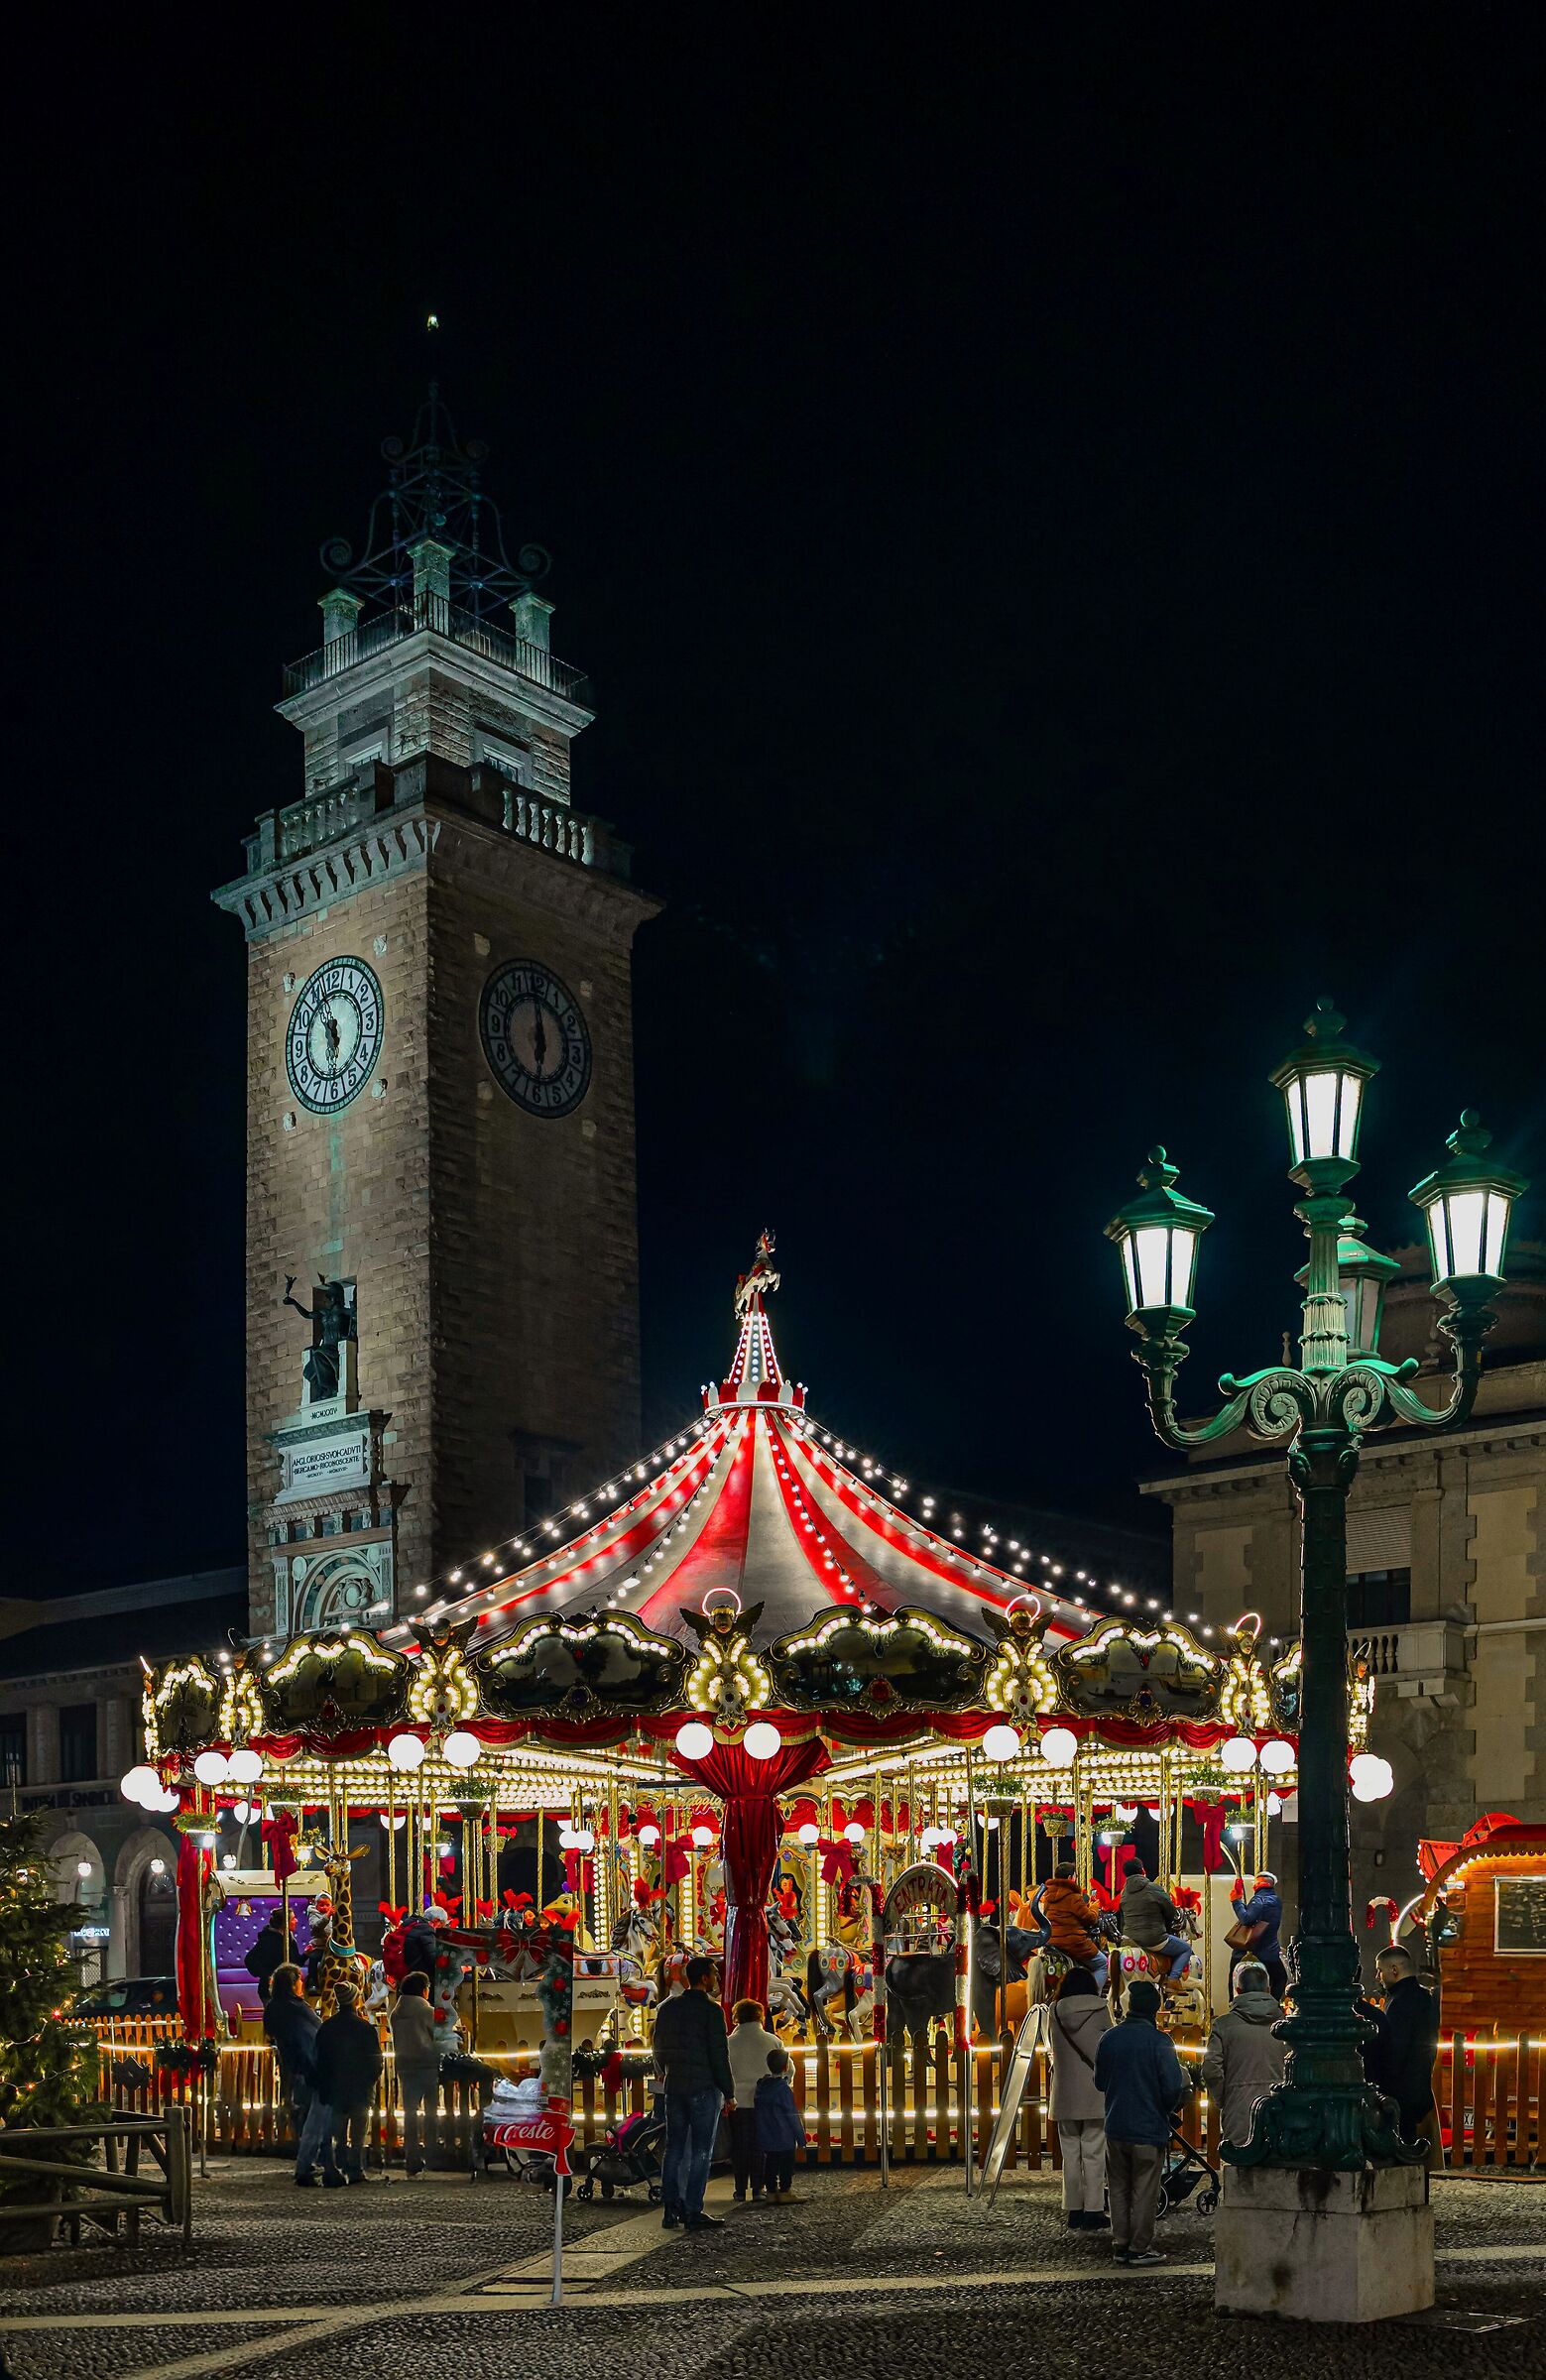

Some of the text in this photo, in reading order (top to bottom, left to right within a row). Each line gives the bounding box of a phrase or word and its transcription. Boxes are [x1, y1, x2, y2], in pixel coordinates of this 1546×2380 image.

[325, 971, 340, 992] 12
[348, 971, 353, 989] 1
[512, 974, 522, 993] 11
[531, 974, 544, 996] 12
[360, 984, 369, 1002] 2
[495, 989, 508, 1008] 10
[553, 992, 558, 1008] 1
[297, 1010, 309, 1029] 10
[366, 1012, 374, 1030] 3
[492, 1015, 500, 1032] 9
[567, 1014, 576, 1033] 2
[296, 1040, 303, 1058] 9
[360, 1043, 368, 1061] 4
[497, 1043, 505, 1062] 8
[572, 1045, 580, 1064] 3
[300, 1065, 307, 1083] 8
[348, 1067, 356, 1086] 5
[512, 1069, 521, 1088] 7
[566, 1071, 574, 1088] 4
[313, 1081, 321, 1100] 7
[330, 1081, 337, 1100] 6
[533, 1086, 540, 1103] 6
[552, 1086, 561, 1104] 5
[894, 1875, 947, 1915] ENTRATA
